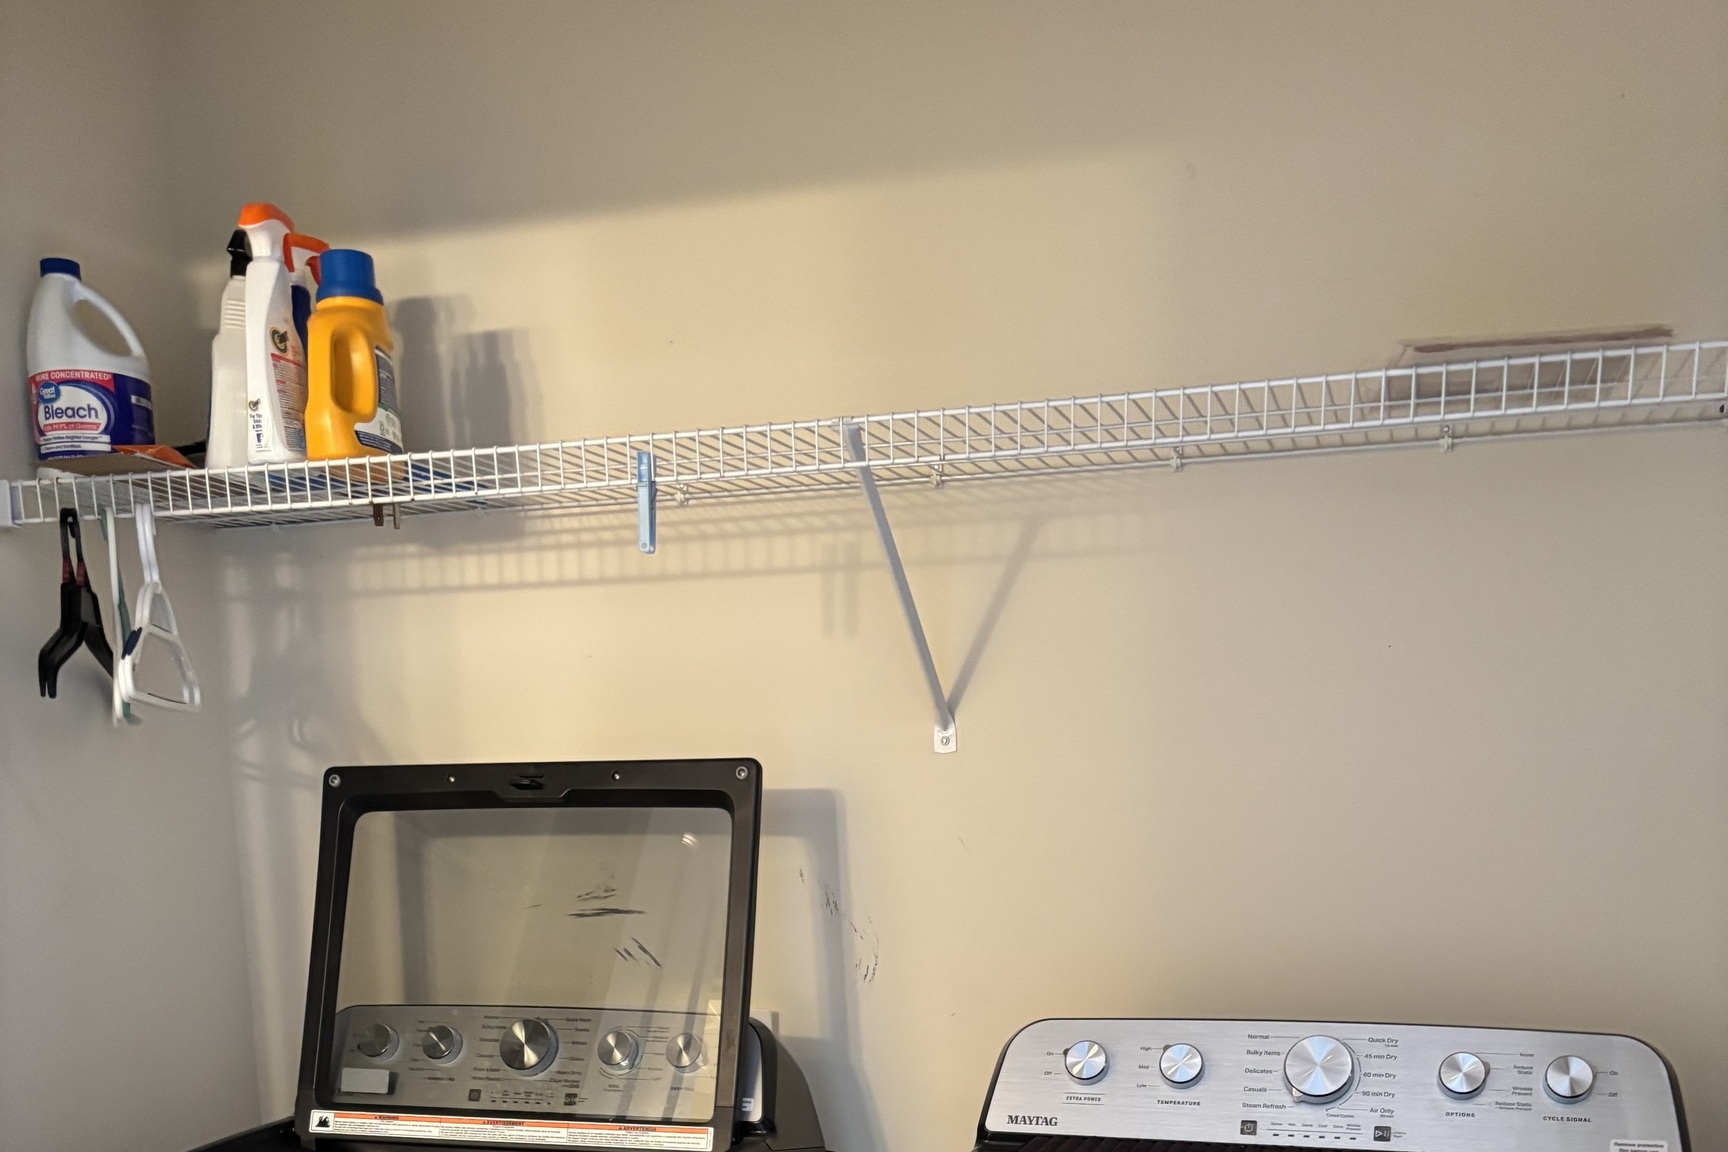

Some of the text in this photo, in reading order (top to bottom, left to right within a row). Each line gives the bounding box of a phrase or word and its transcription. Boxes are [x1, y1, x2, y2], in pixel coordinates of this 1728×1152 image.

[50, 371, 109, 380] CONCENTRATED
[44, 404, 99, 421] Bleach
[1367, 1036, 1399, 1045] Quick Dry
[1246, 1049, 1263, 1057] Bulky
[1244, 1067, 1273, 1075] Delicates
[1363, 1071, 1372, 1079] 60
[1157, 1099, 1201, 1107] TEMPERATURE
[1379, 1107, 1395, 1115] Only
[1006, 1114, 1059, 1127] MAYTAG
